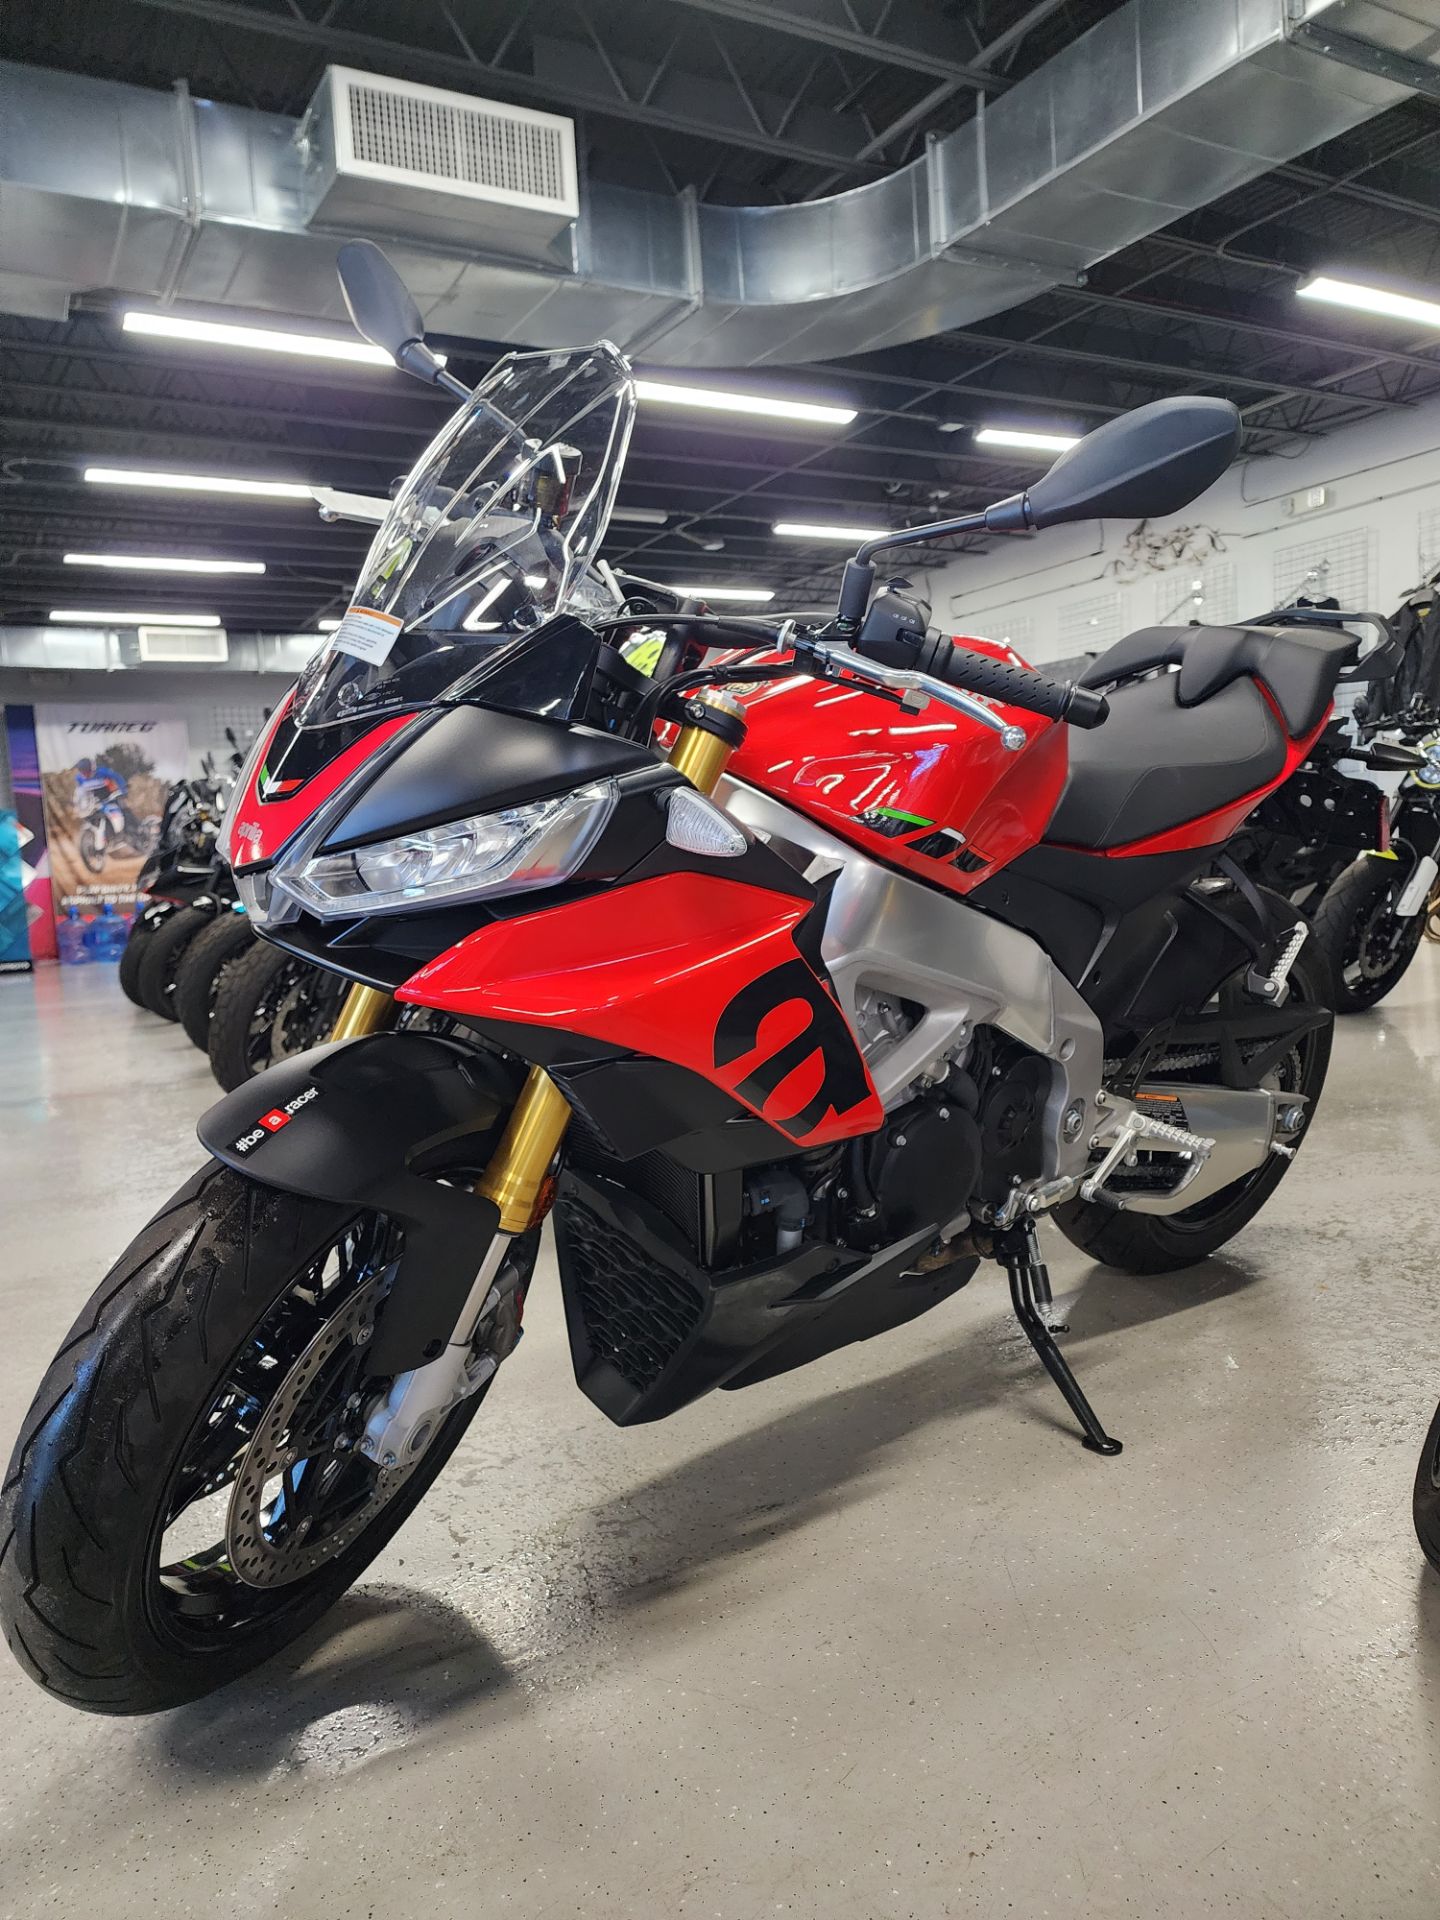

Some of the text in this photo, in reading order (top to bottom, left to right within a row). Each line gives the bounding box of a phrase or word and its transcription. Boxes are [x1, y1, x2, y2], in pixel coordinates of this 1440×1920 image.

[236, 1087, 319, 1152] #be a racer
